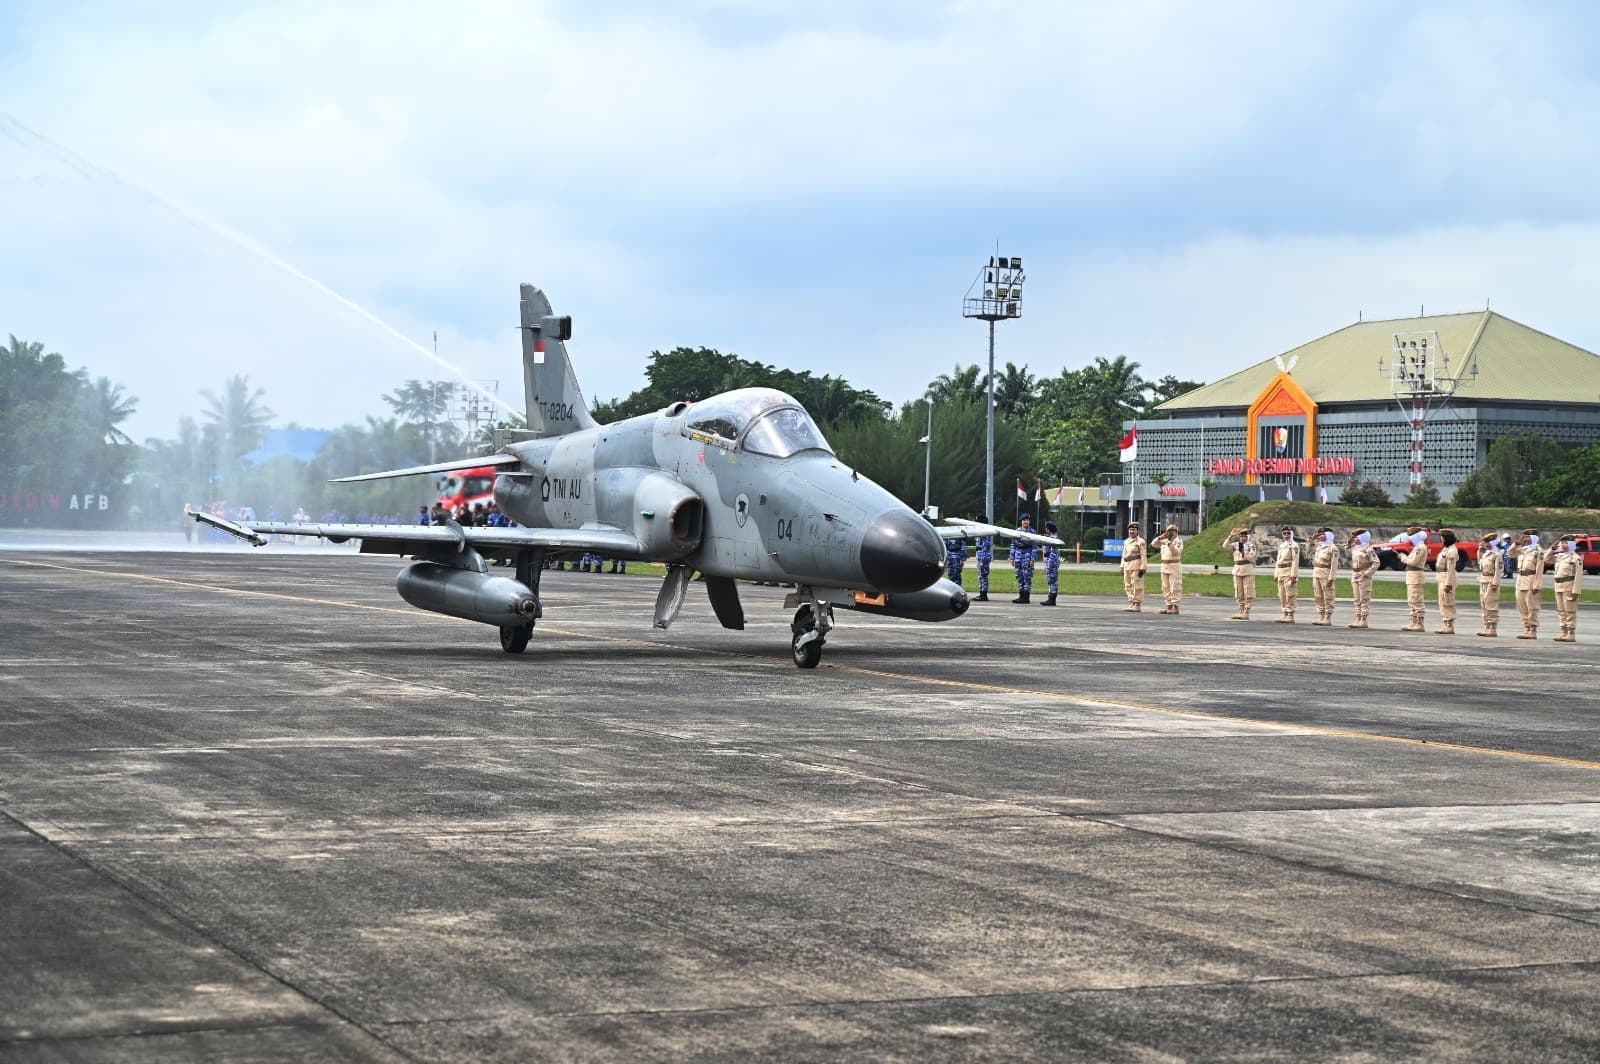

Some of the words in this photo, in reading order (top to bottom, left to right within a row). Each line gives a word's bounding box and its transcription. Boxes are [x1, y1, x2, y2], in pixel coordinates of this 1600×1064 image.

[539, 401, 574, 422] TT-0204
[1207, 458, 1244, 474] LANUD
[1246, 458, 1296, 474] ROESMIN
[1297, 457, 1355, 474] NURJADIN
[553, 478, 567, 499] TNI
[569, 478, 582, 499] AU
[69, 493, 109, 510] AFB
[777, 518, 793, 541] 04
